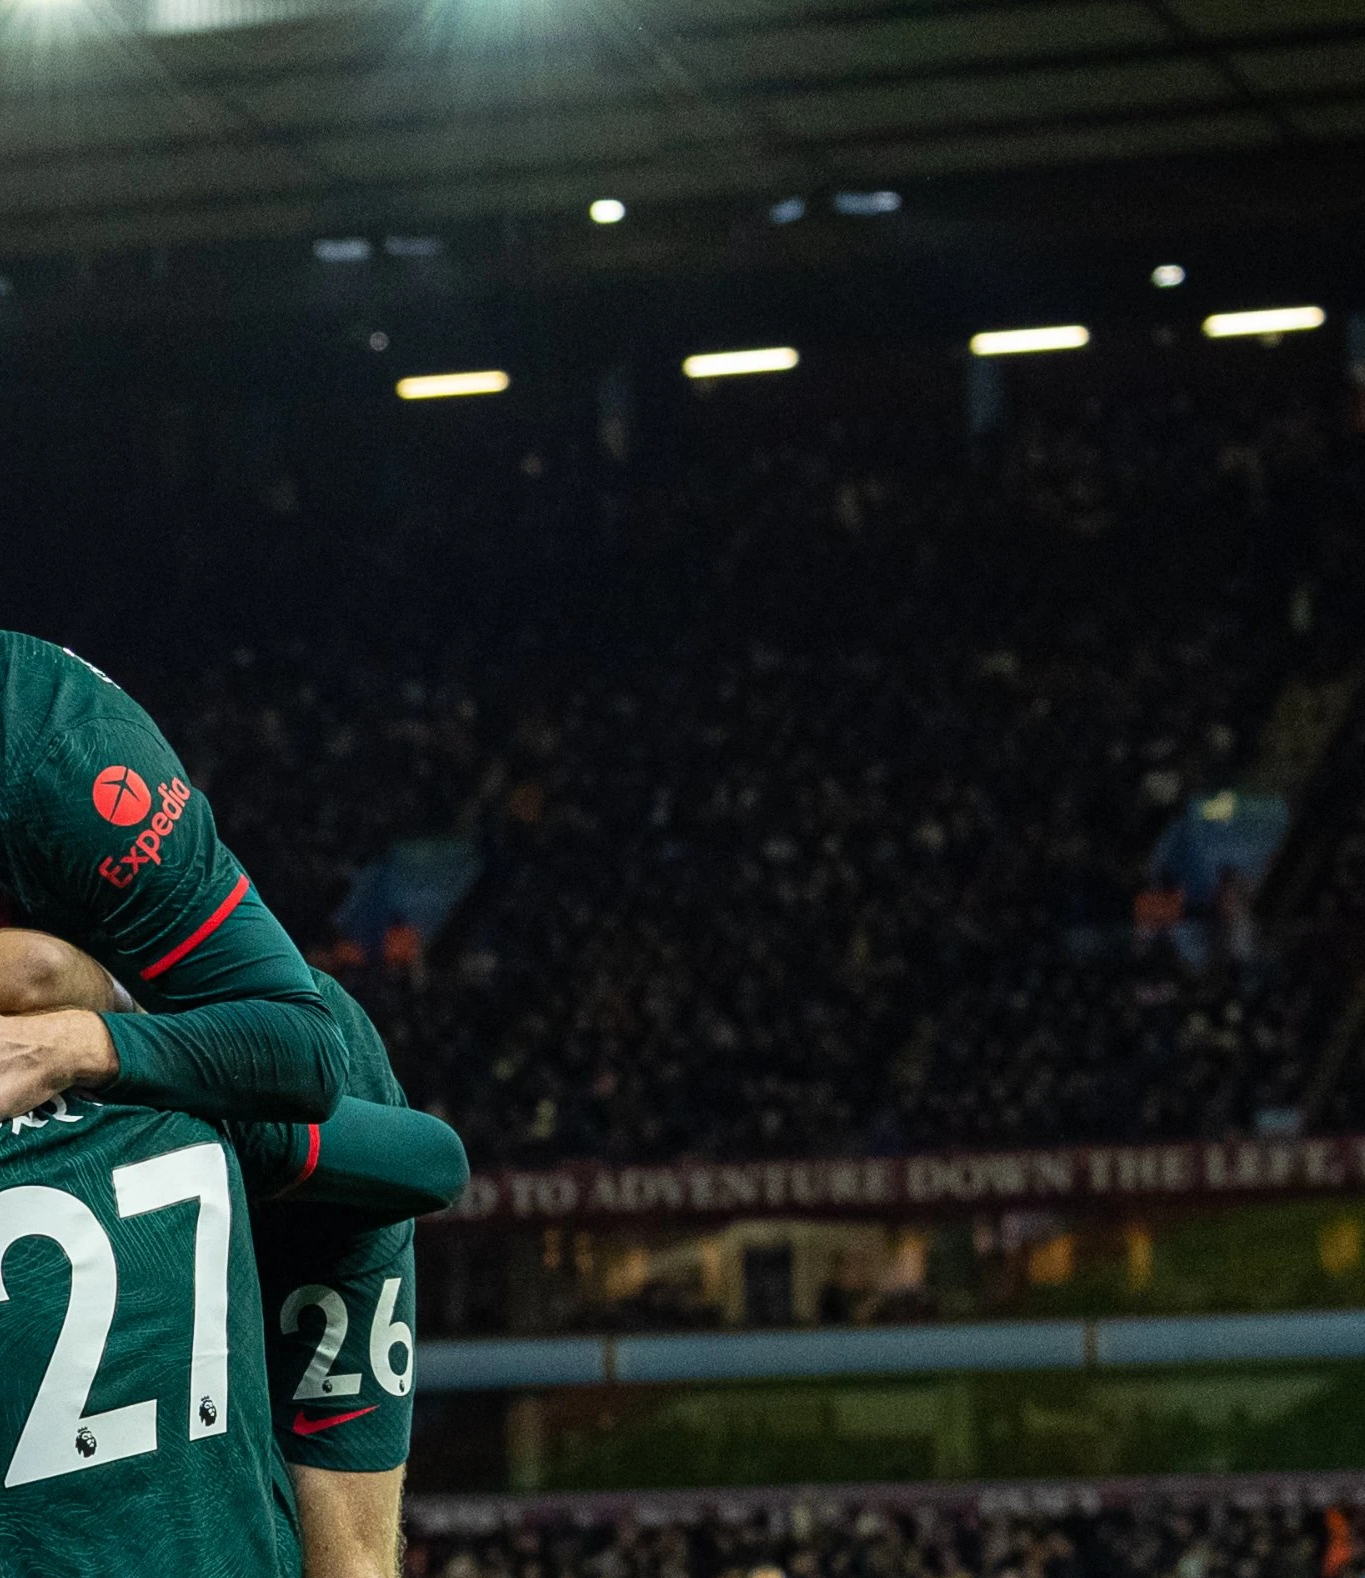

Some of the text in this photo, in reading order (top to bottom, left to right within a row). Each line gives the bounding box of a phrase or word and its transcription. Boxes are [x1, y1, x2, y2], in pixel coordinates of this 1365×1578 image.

[98, 776, 192, 888] Expedia
[511, 1169, 578, 1217] TO
[588, 1155, 898, 1212] ADVENTURE
[905, 1149, 1072, 1198] DOWN
[1084, 1144, 1187, 1194] THE
[279, 1277, 414, 1398] 26
